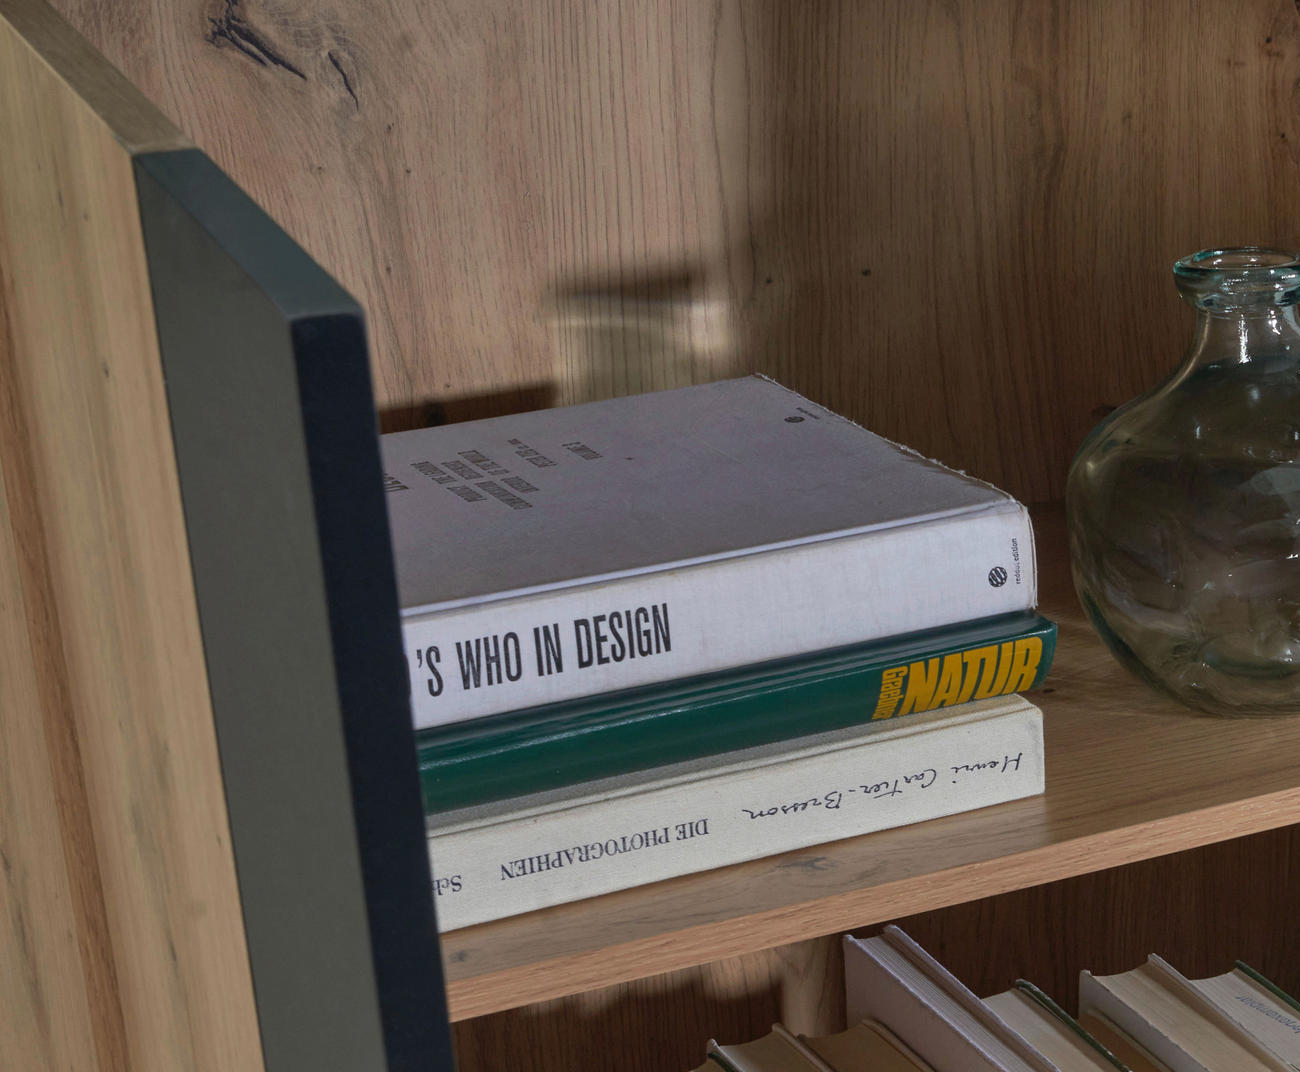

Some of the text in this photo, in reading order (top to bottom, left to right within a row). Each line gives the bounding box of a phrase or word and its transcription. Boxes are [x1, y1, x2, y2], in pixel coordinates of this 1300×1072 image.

[404, 603, 672, 697] 'S WHO IN DESIGN
[896, 636, 1043, 717] NATUR
[431, 818, 709, 896] DIE PHOTOGRAPHIEN Sch
